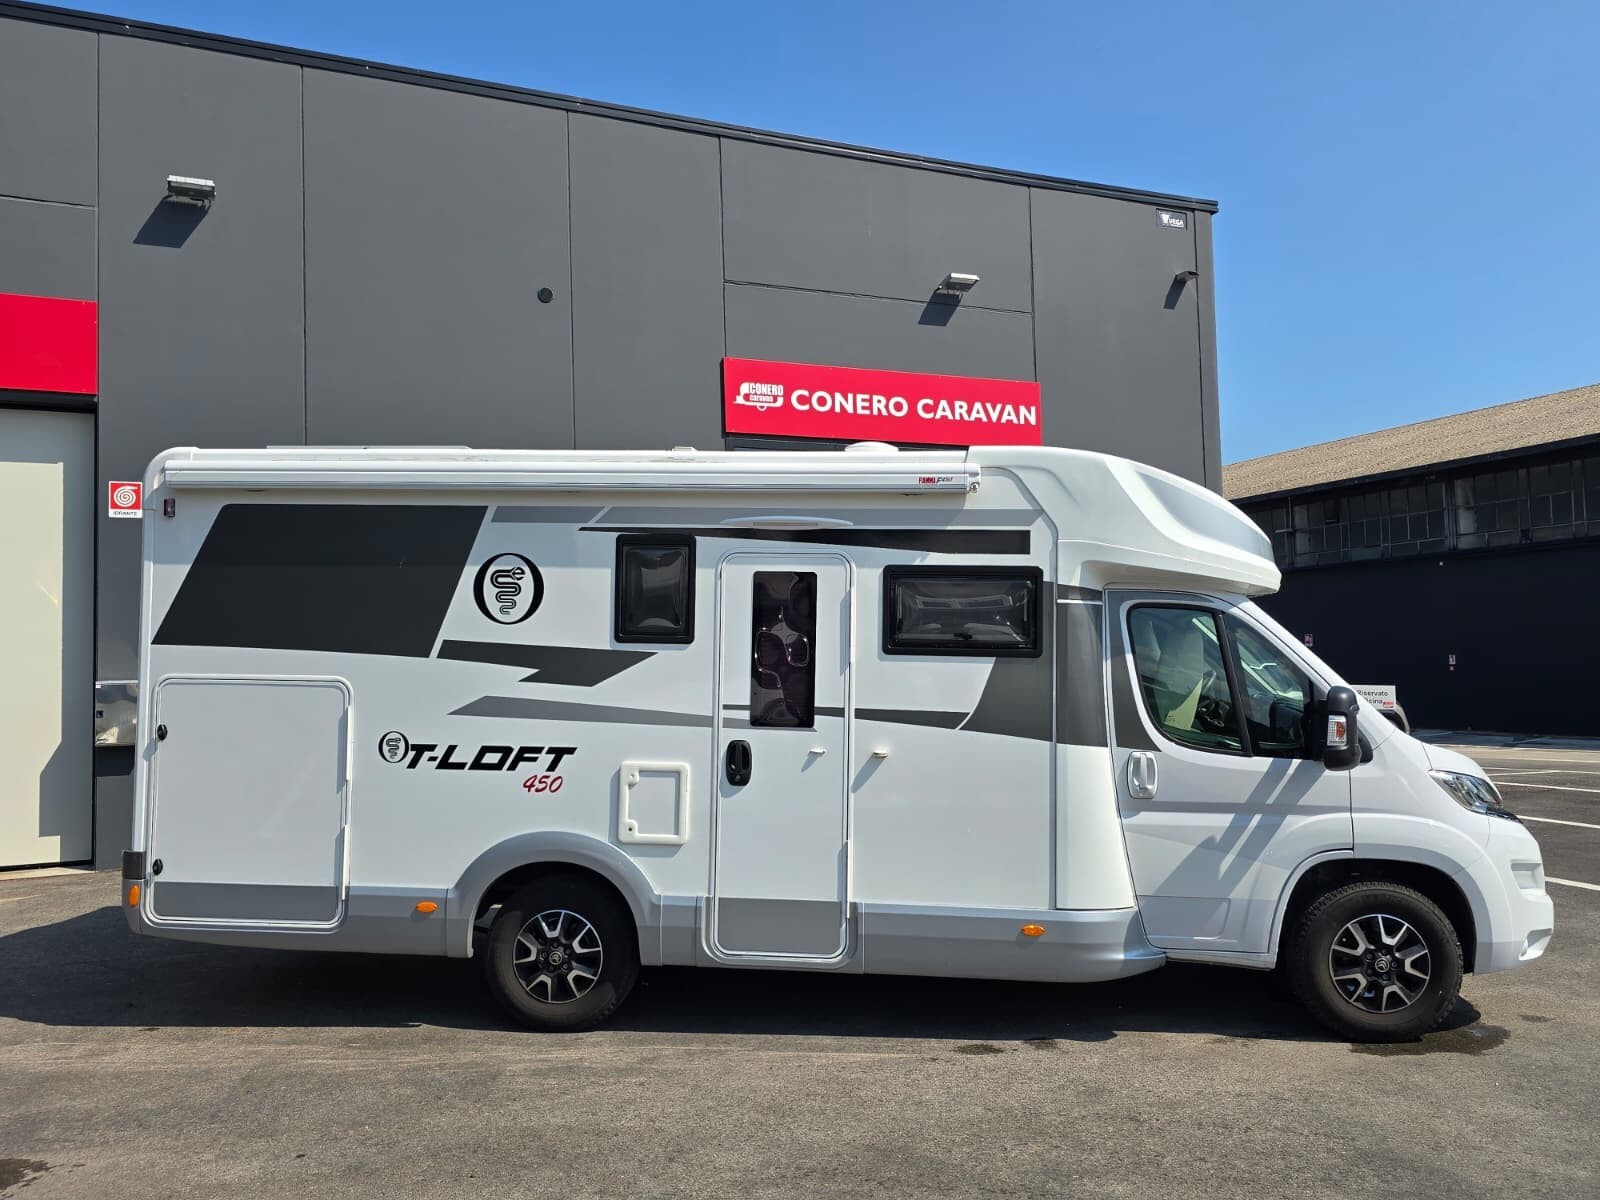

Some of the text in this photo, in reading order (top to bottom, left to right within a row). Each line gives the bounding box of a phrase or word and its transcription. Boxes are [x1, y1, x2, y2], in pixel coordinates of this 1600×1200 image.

[749, 382, 784, 396] CONERO
[790, 389, 1037, 426] CONERO CARAVAN
[406, 743, 578, 772] T-LOFT
[522, 774, 563, 793] 450
